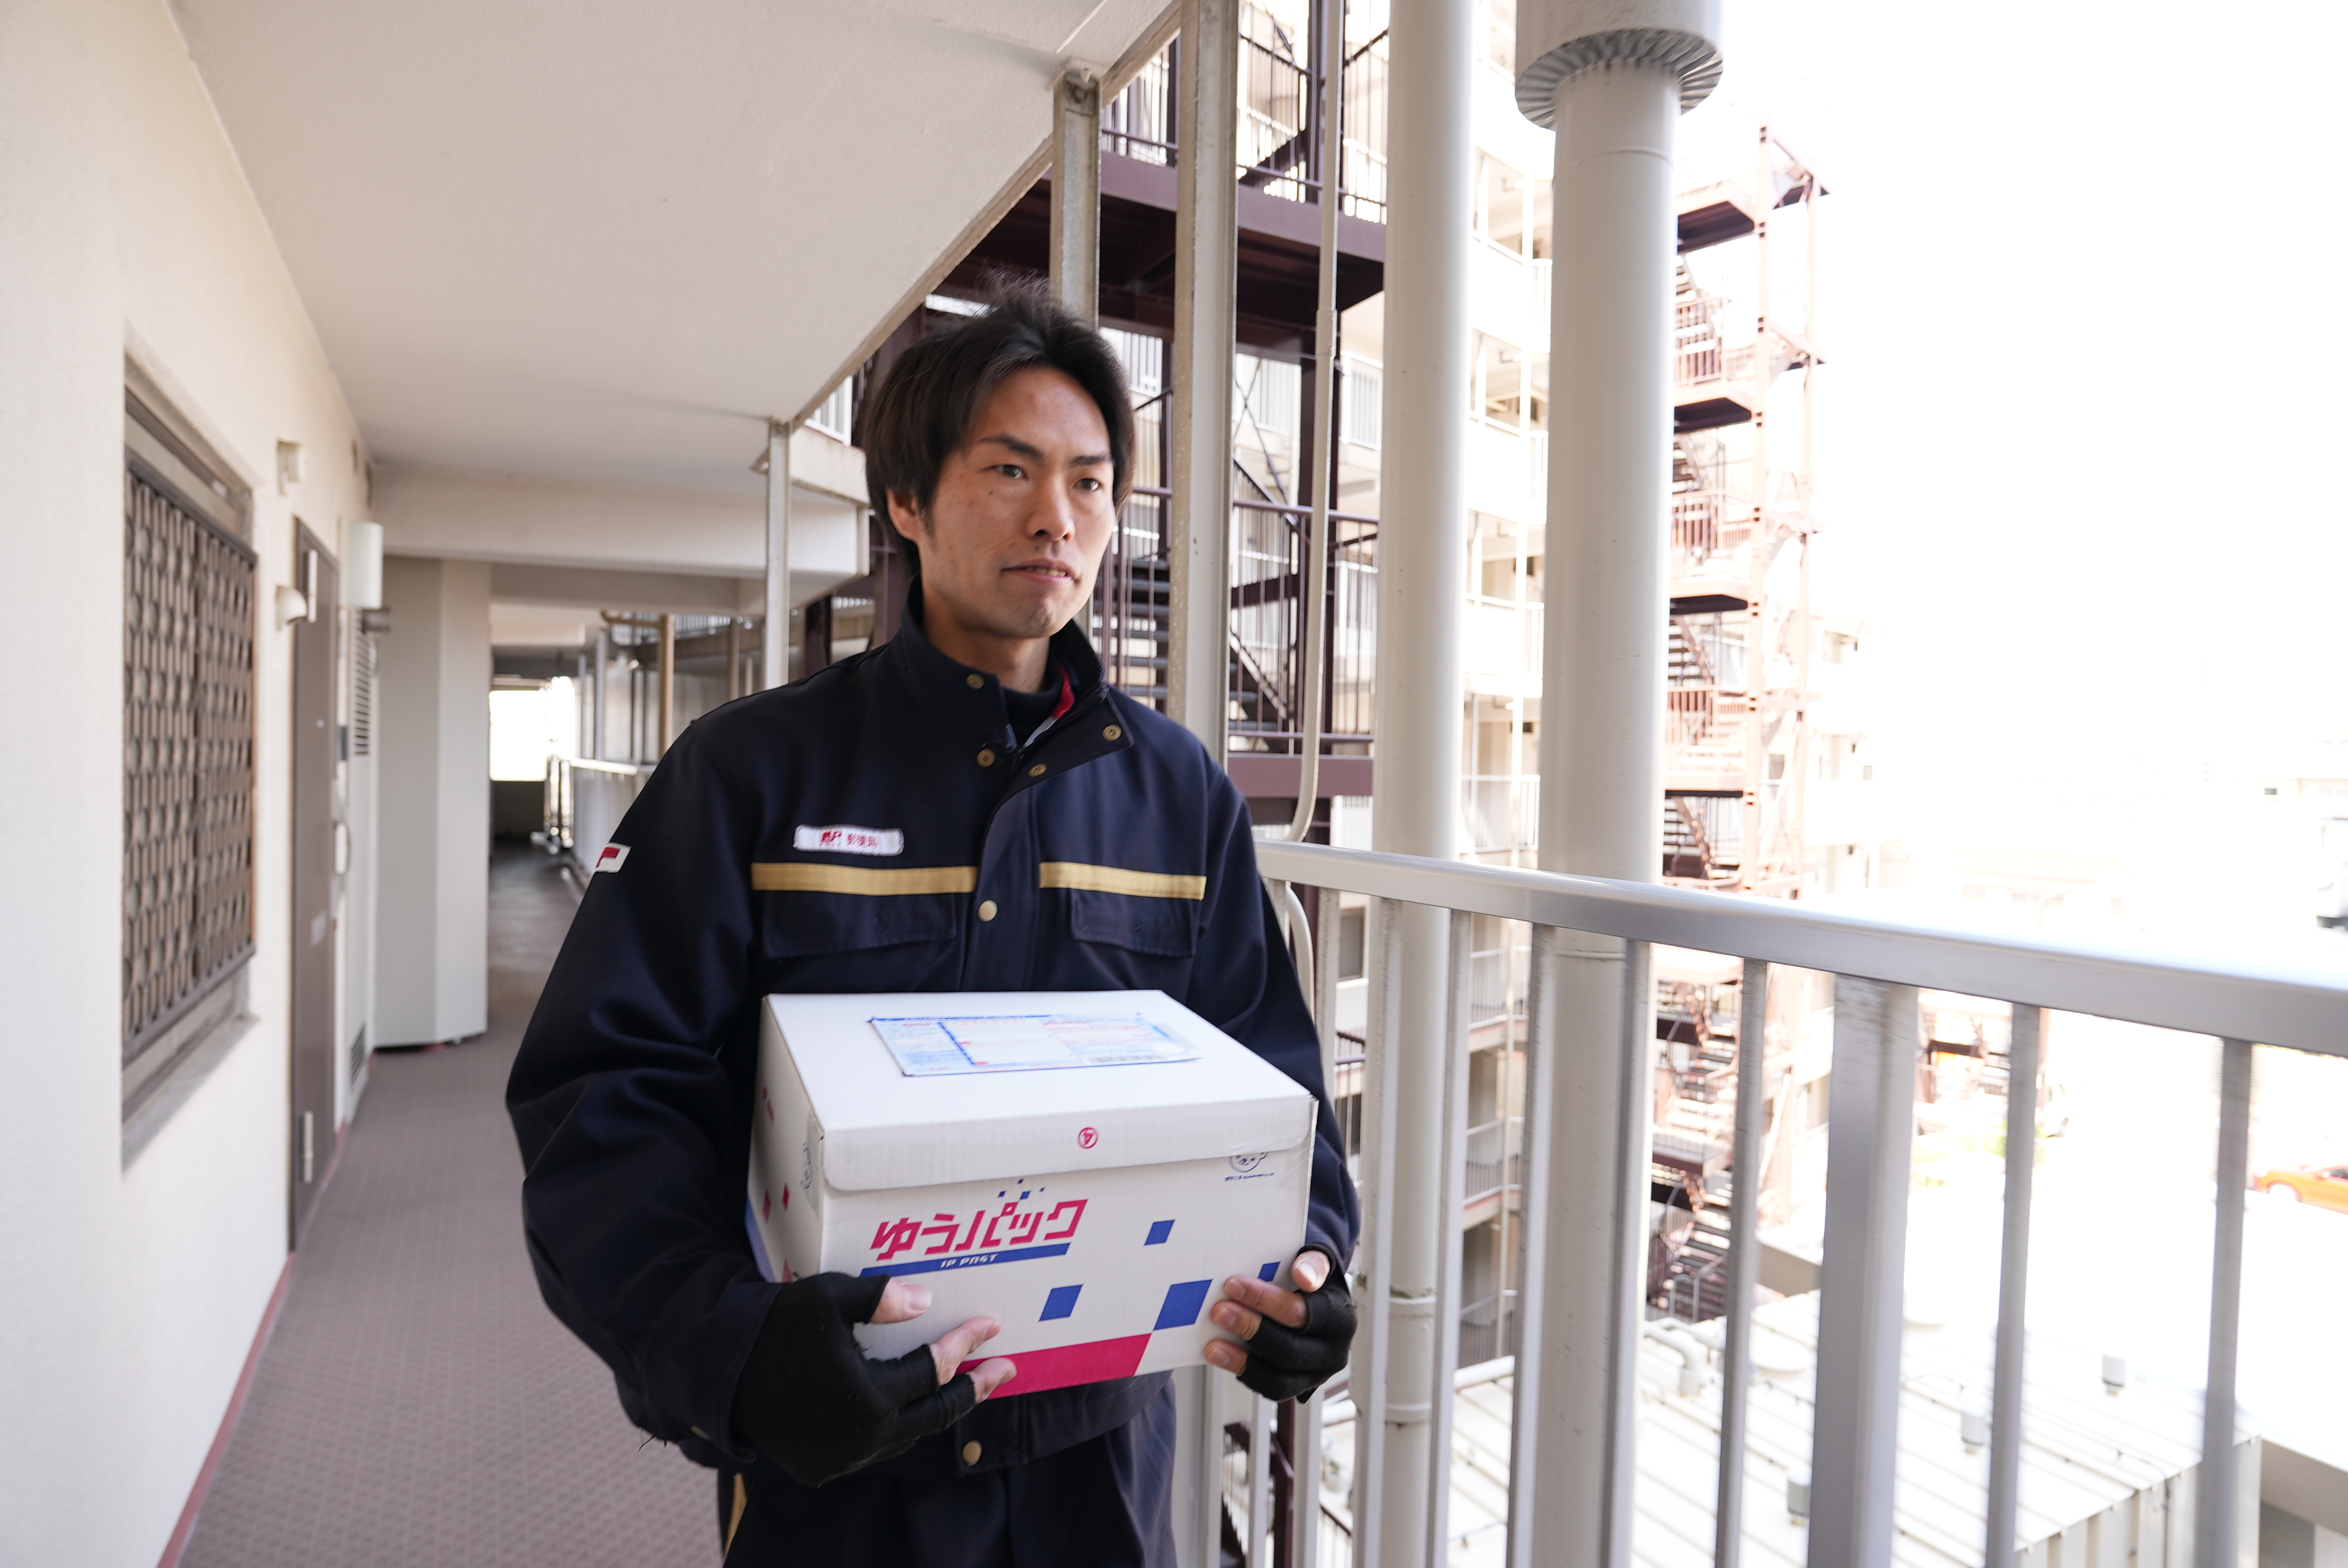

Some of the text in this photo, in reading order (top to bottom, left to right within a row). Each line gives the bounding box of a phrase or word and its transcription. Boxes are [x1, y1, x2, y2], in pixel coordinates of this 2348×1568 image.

[869, 1198, 1089, 1261] ゆうパック
[959, 1253, 999, 1266] POST
